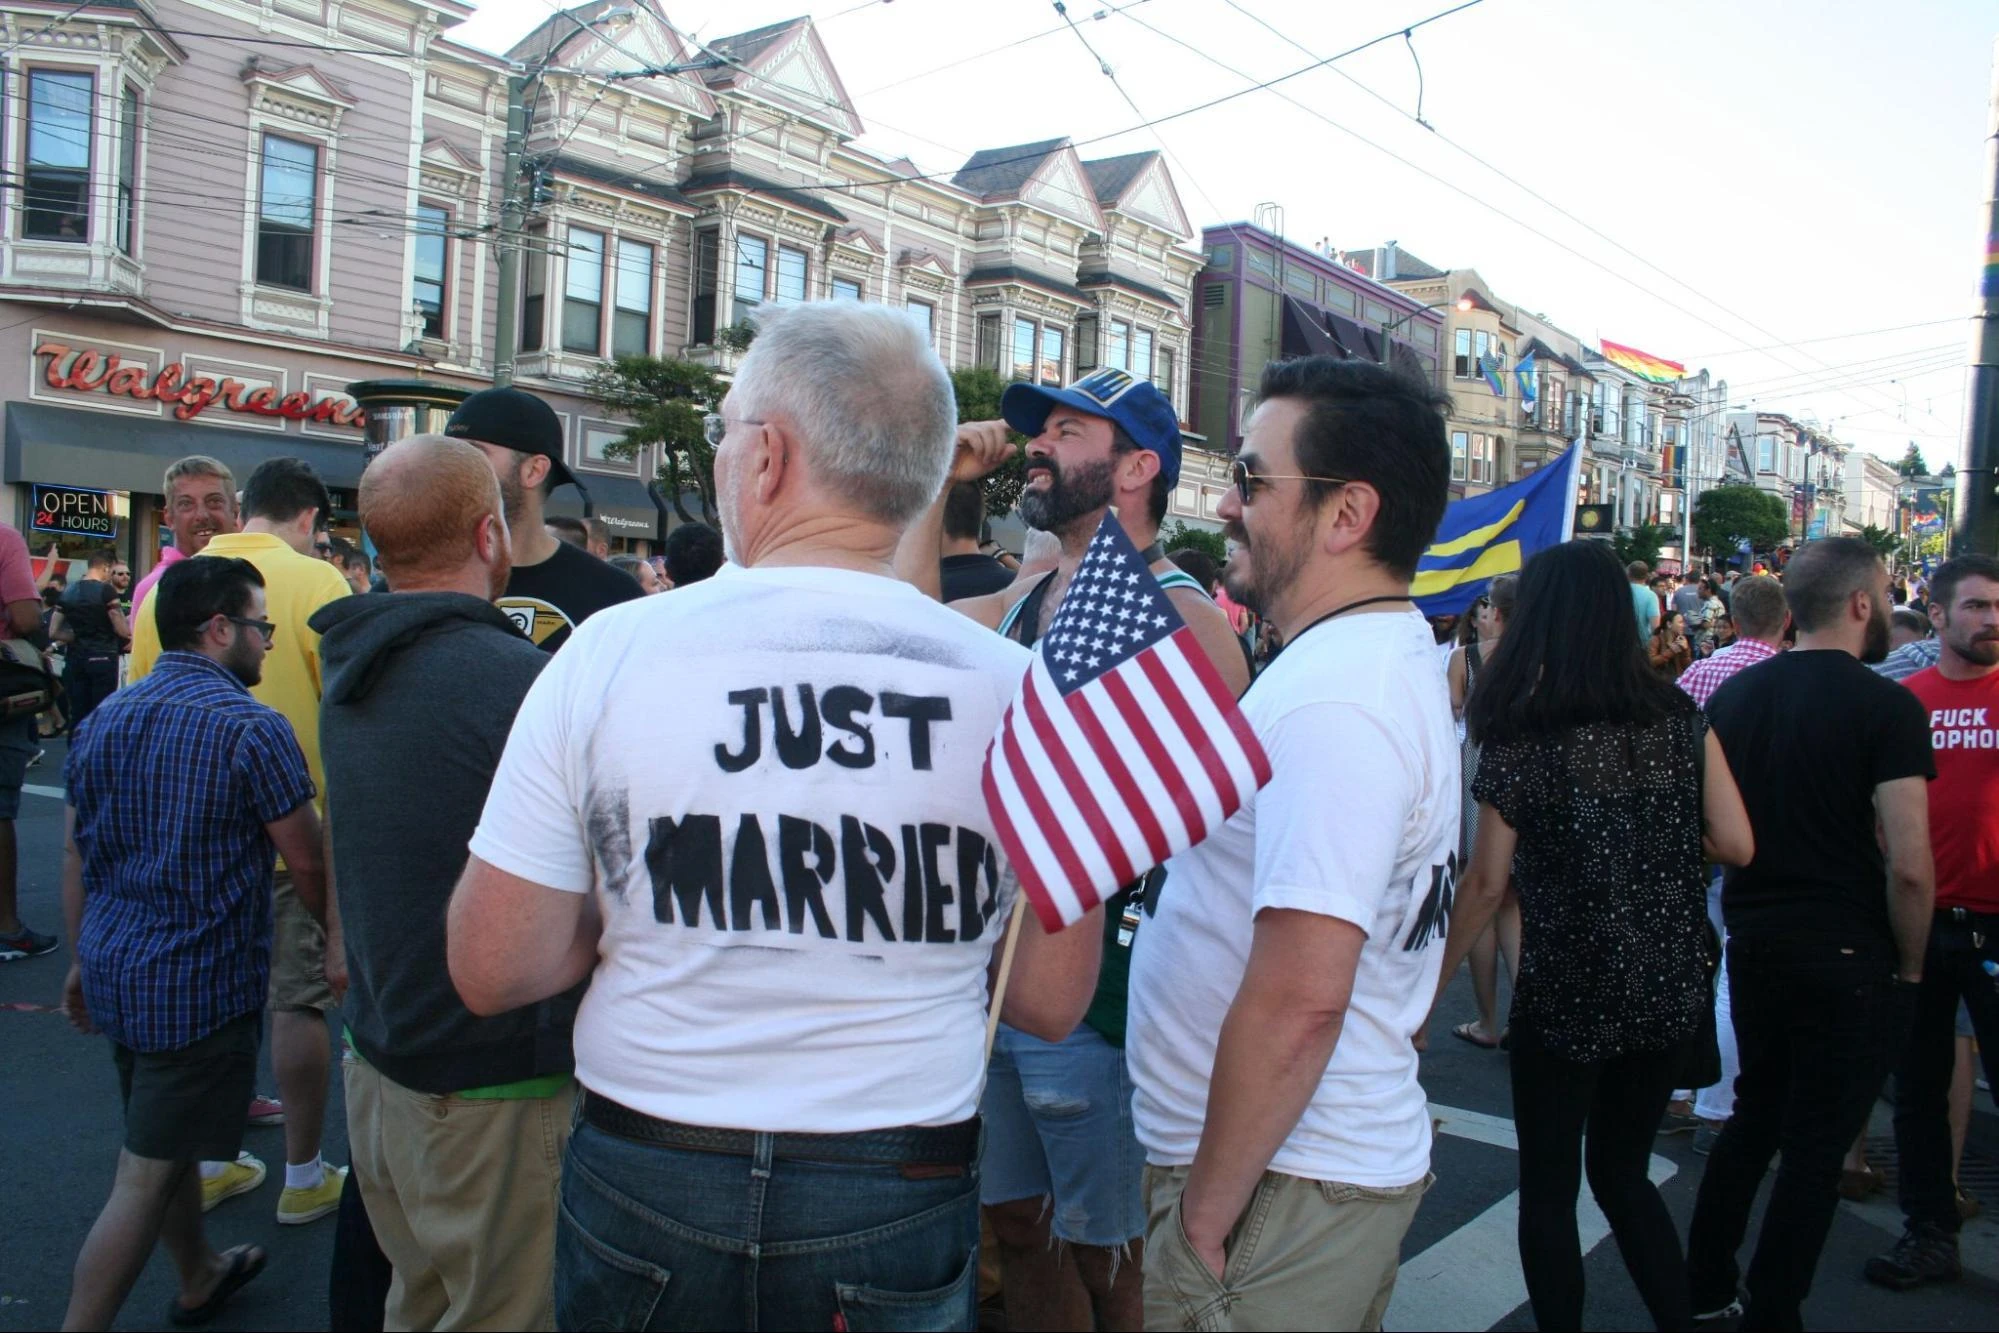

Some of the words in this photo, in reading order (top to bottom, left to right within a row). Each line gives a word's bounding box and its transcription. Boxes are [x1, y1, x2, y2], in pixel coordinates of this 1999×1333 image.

[43, 492, 108, 514] OPEN
[36, 511, 54, 526] 24
[61, 514, 109, 532] HOURS
[607, 516, 649, 529] Walgreens
[713, 683, 953, 773] JUST
[1929, 707, 1987, 728] FUCK
[644, 813, 999, 943] MARRIED
